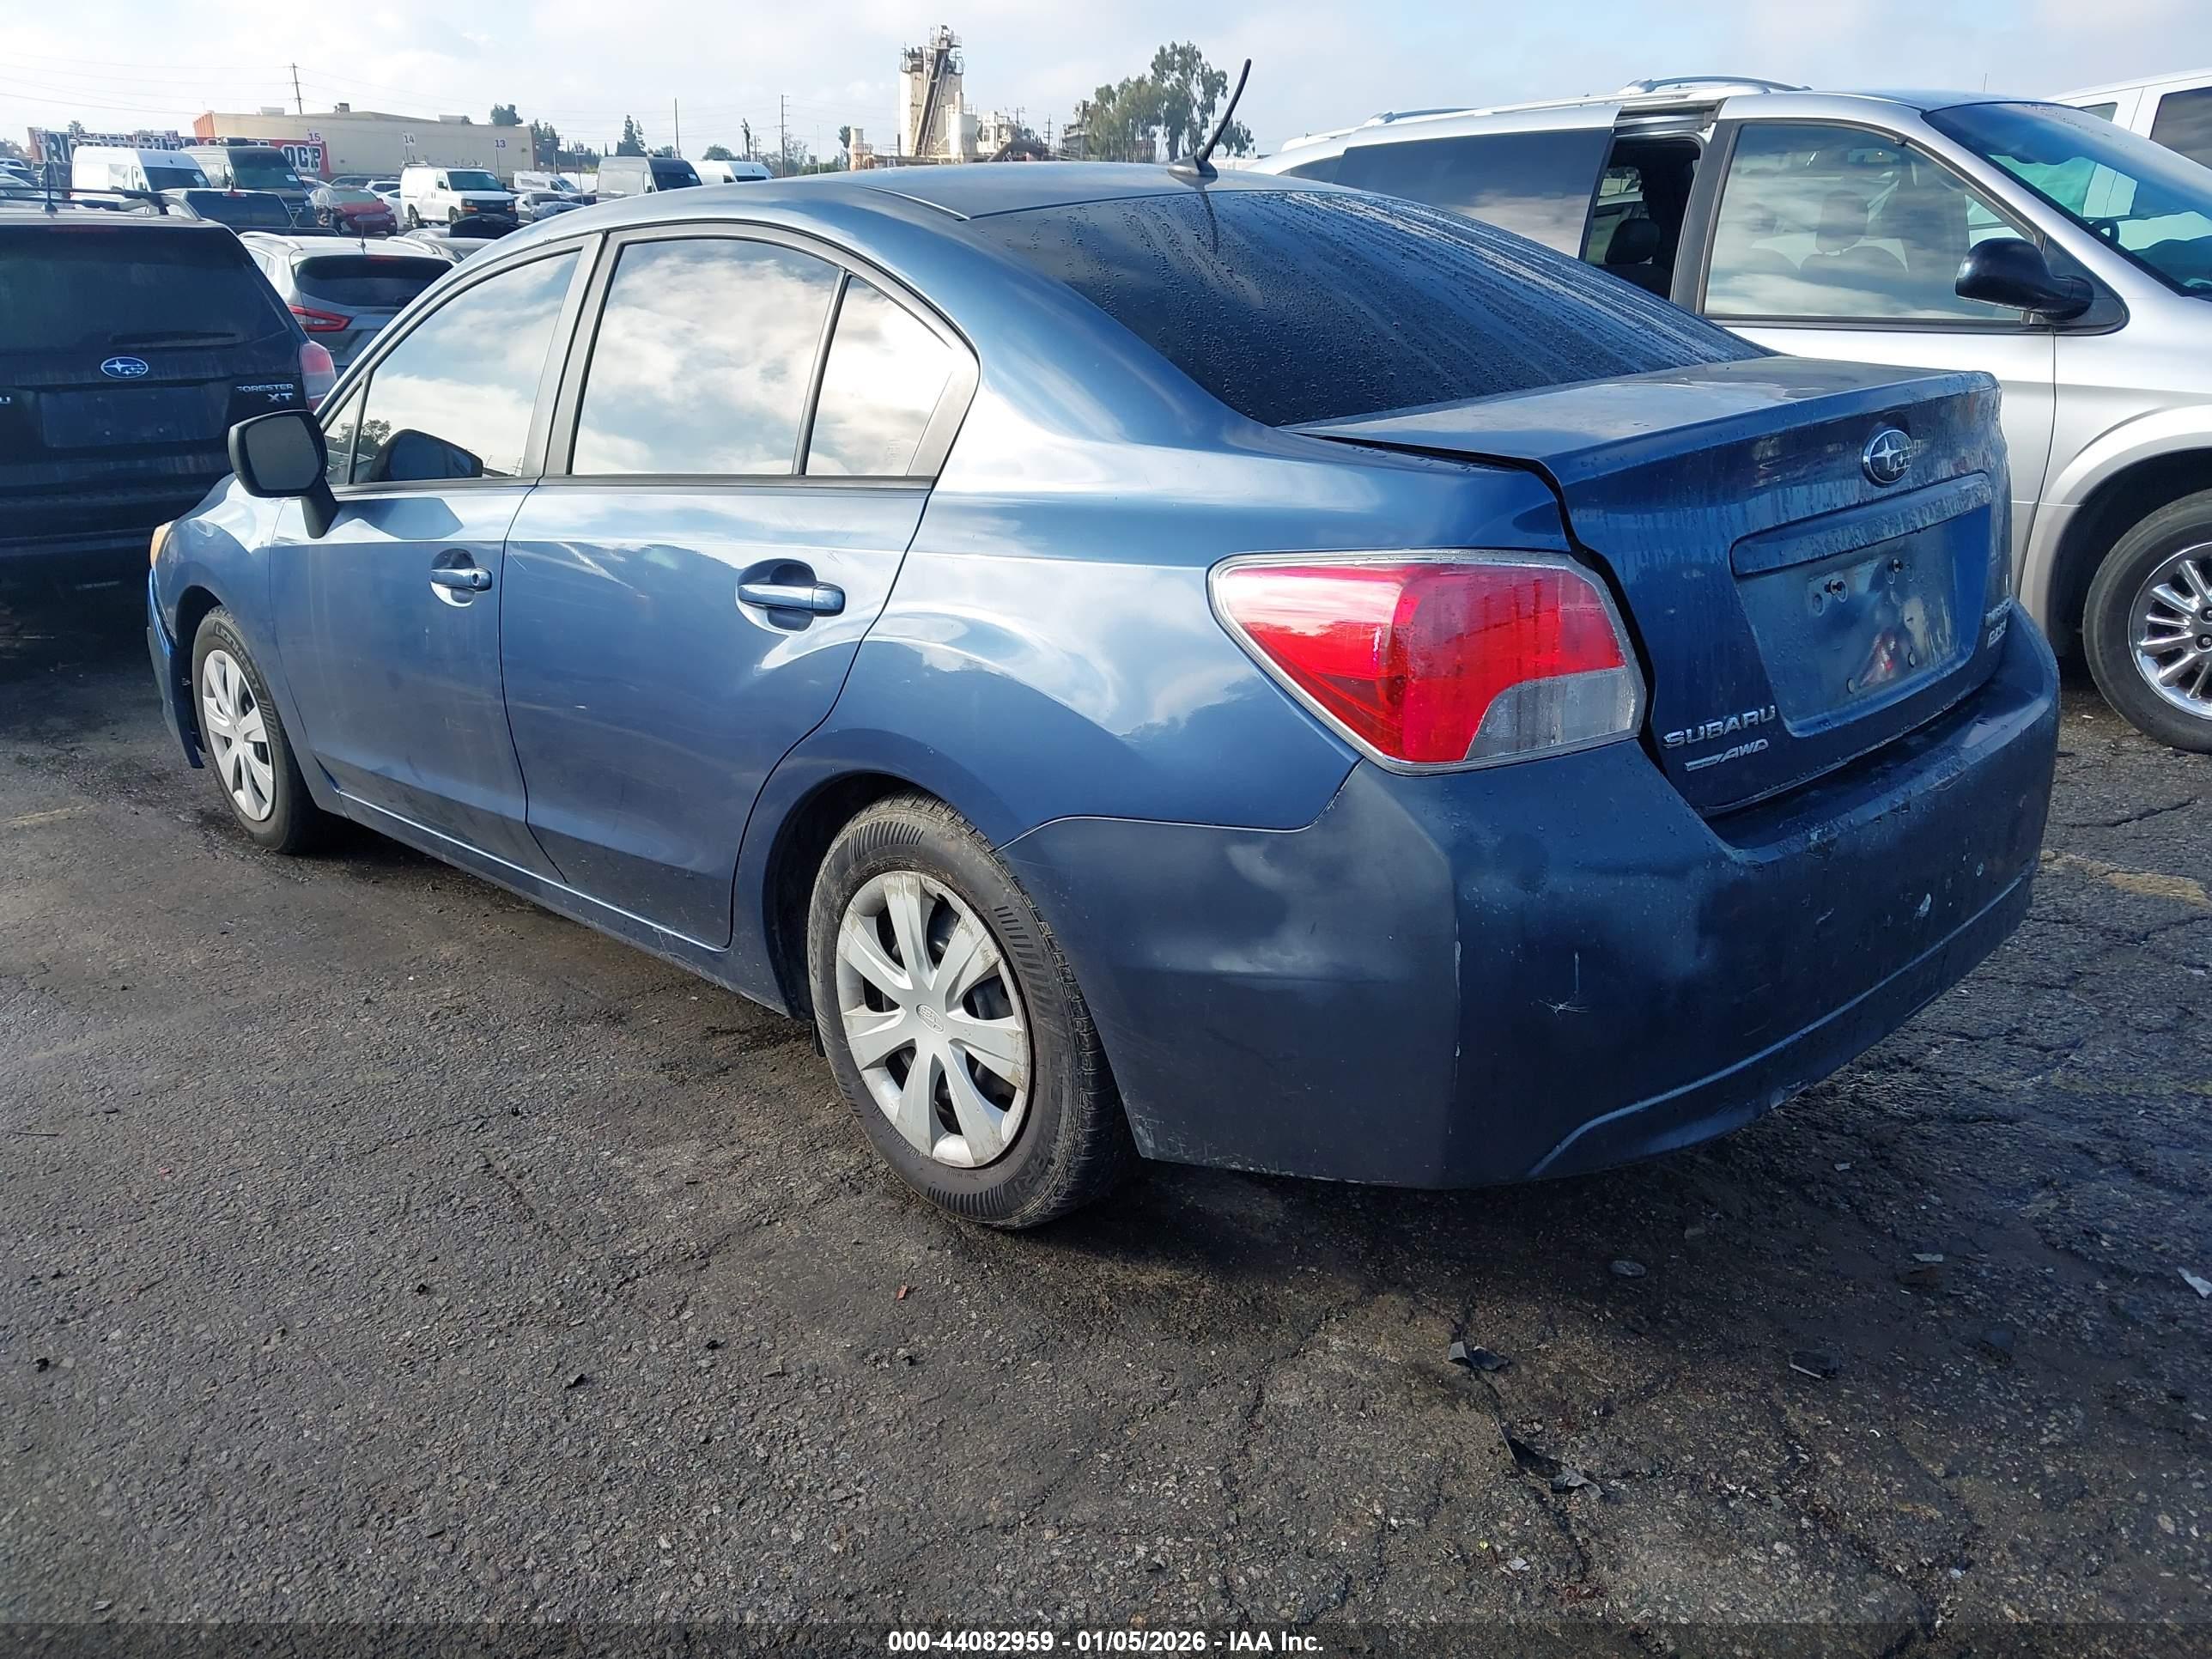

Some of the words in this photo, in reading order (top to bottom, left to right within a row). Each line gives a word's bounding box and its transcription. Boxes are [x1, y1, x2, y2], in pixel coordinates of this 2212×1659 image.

[309, 132, 321, 142] 15
[404, 135, 415, 143] 14
[495, 139, 506, 148] 13
[575, 143, 585, 153] 12
[235, 383, 294, 392] FORESTER
[268, 392, 294, 402] XT
[1662, 703, 1777, 749] SUBARU
[1720, 738, 1769, 763] AWD
